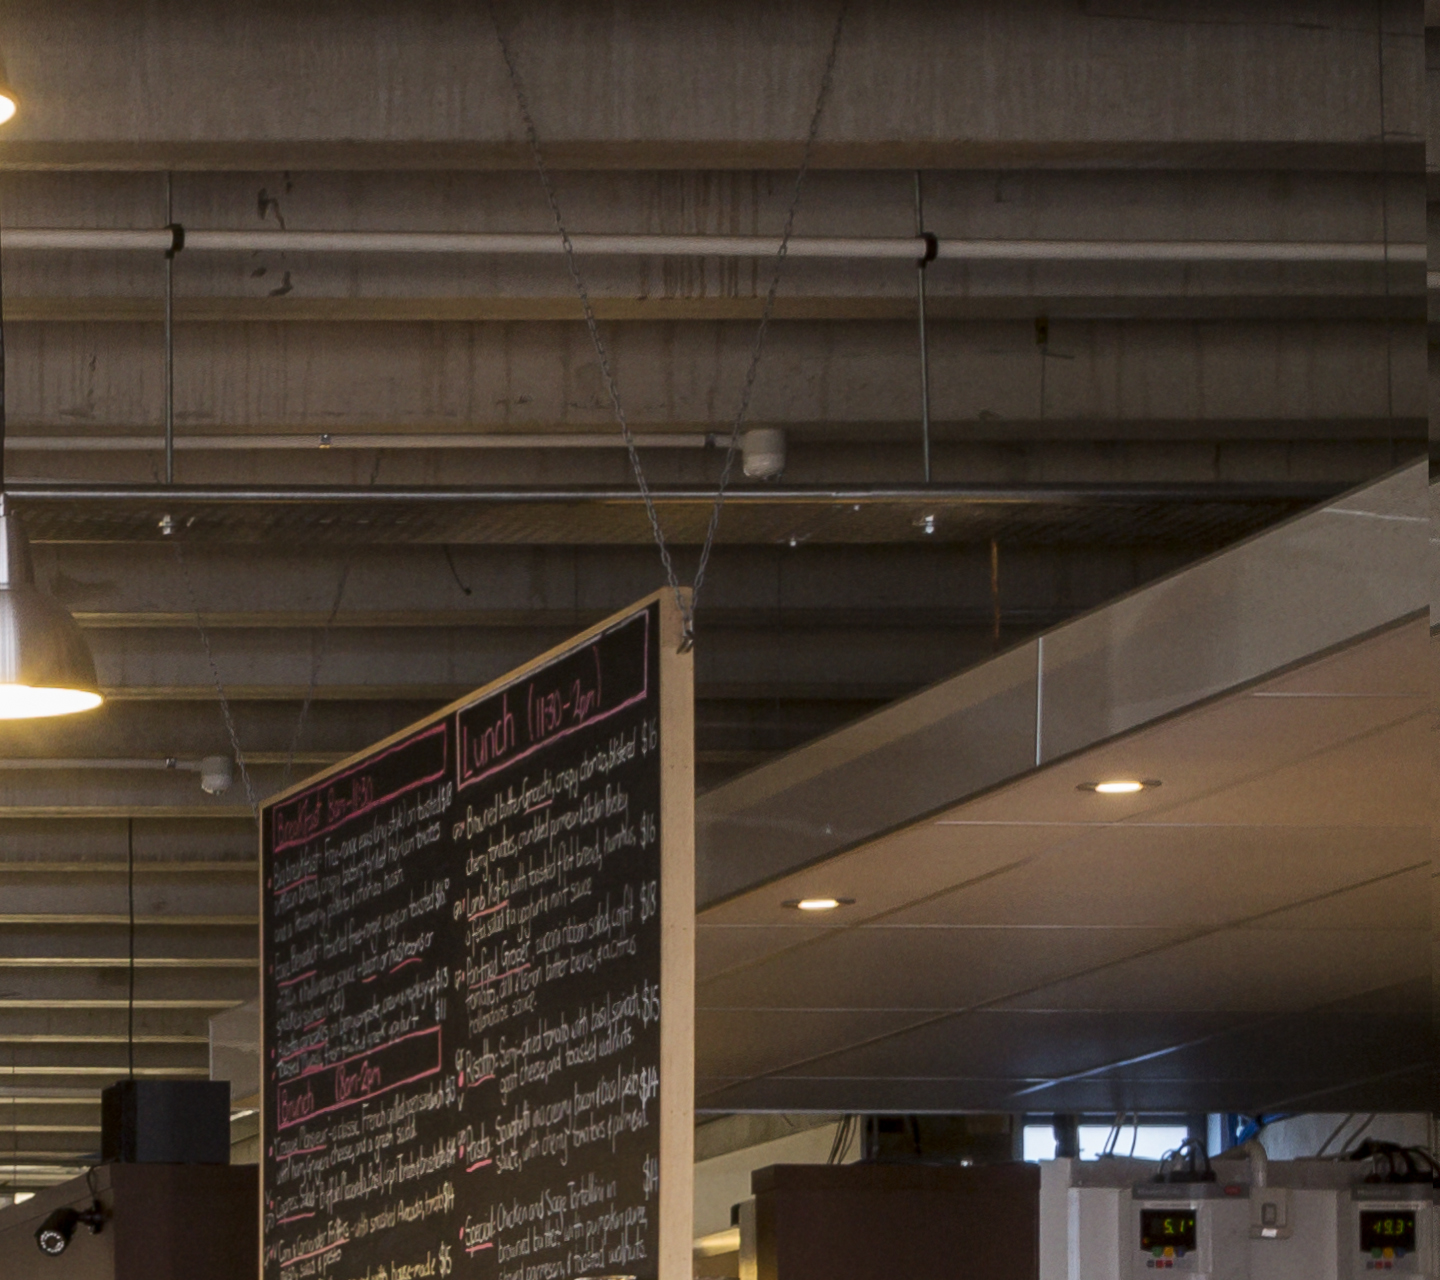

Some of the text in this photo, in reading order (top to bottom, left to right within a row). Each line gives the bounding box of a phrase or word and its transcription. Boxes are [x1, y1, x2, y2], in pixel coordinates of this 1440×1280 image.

[462, 693, 515, 779] Lunch
[639, 811, 655, 848] $16
[641, 982, 658, 1028] $15
